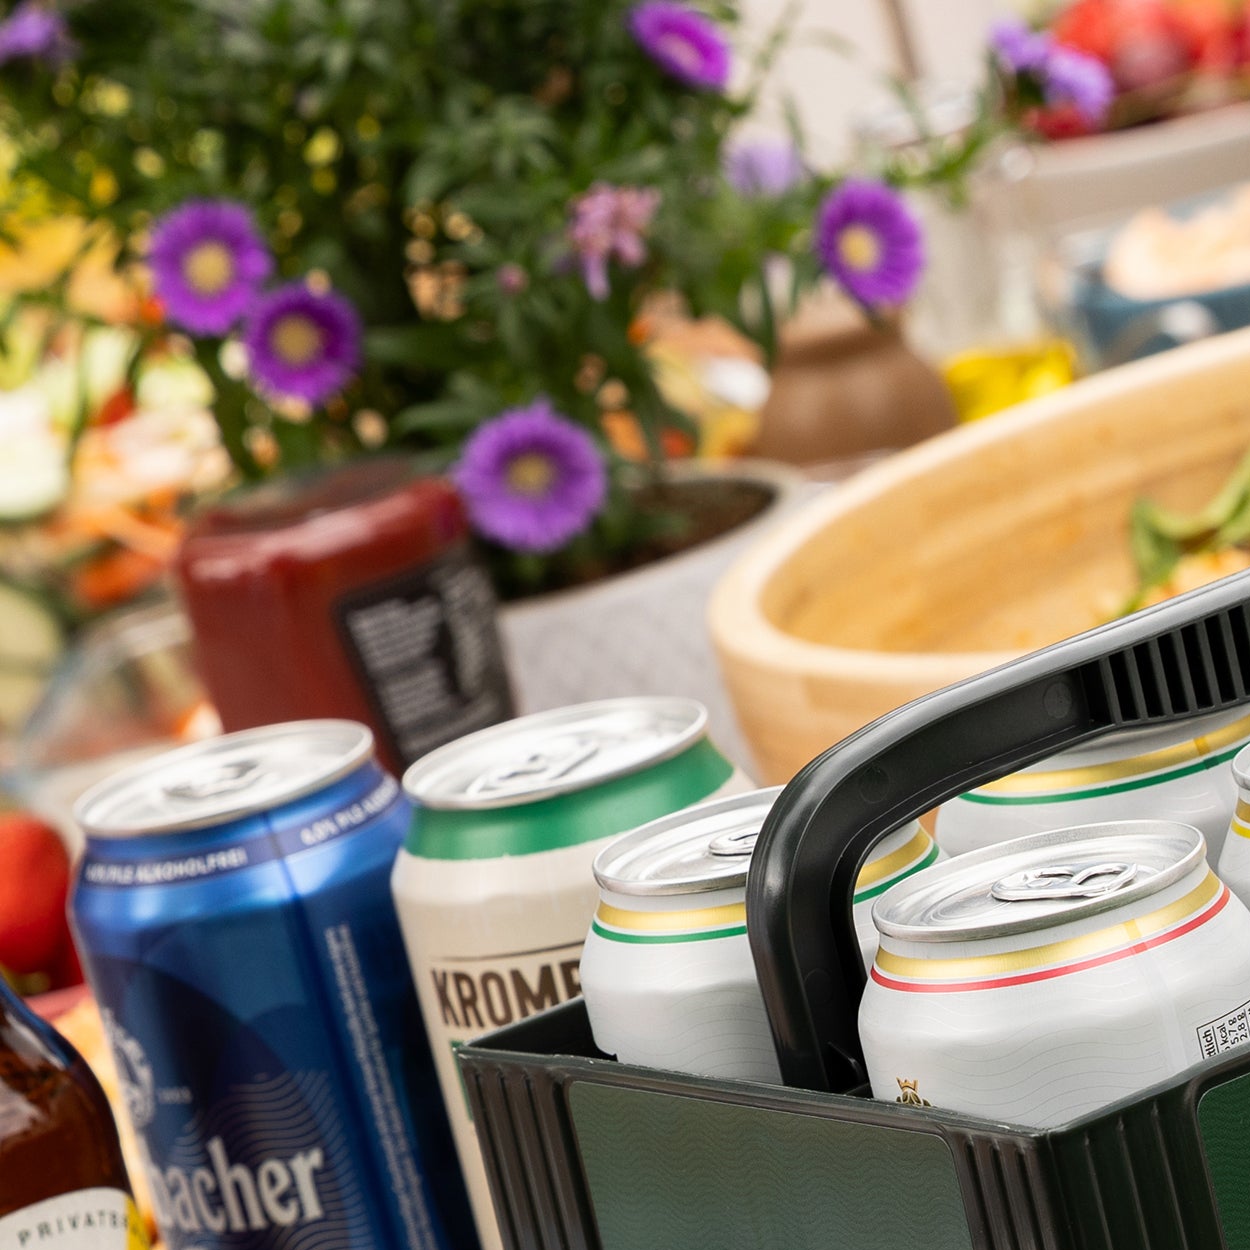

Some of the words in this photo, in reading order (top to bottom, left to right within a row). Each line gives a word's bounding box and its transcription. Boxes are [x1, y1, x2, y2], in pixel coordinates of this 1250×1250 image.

[431, 959, 582, 1028] KROMB
[1216, 1022, 1229, 1046] kcal
[148, 1136, 325, 1234] bacher
